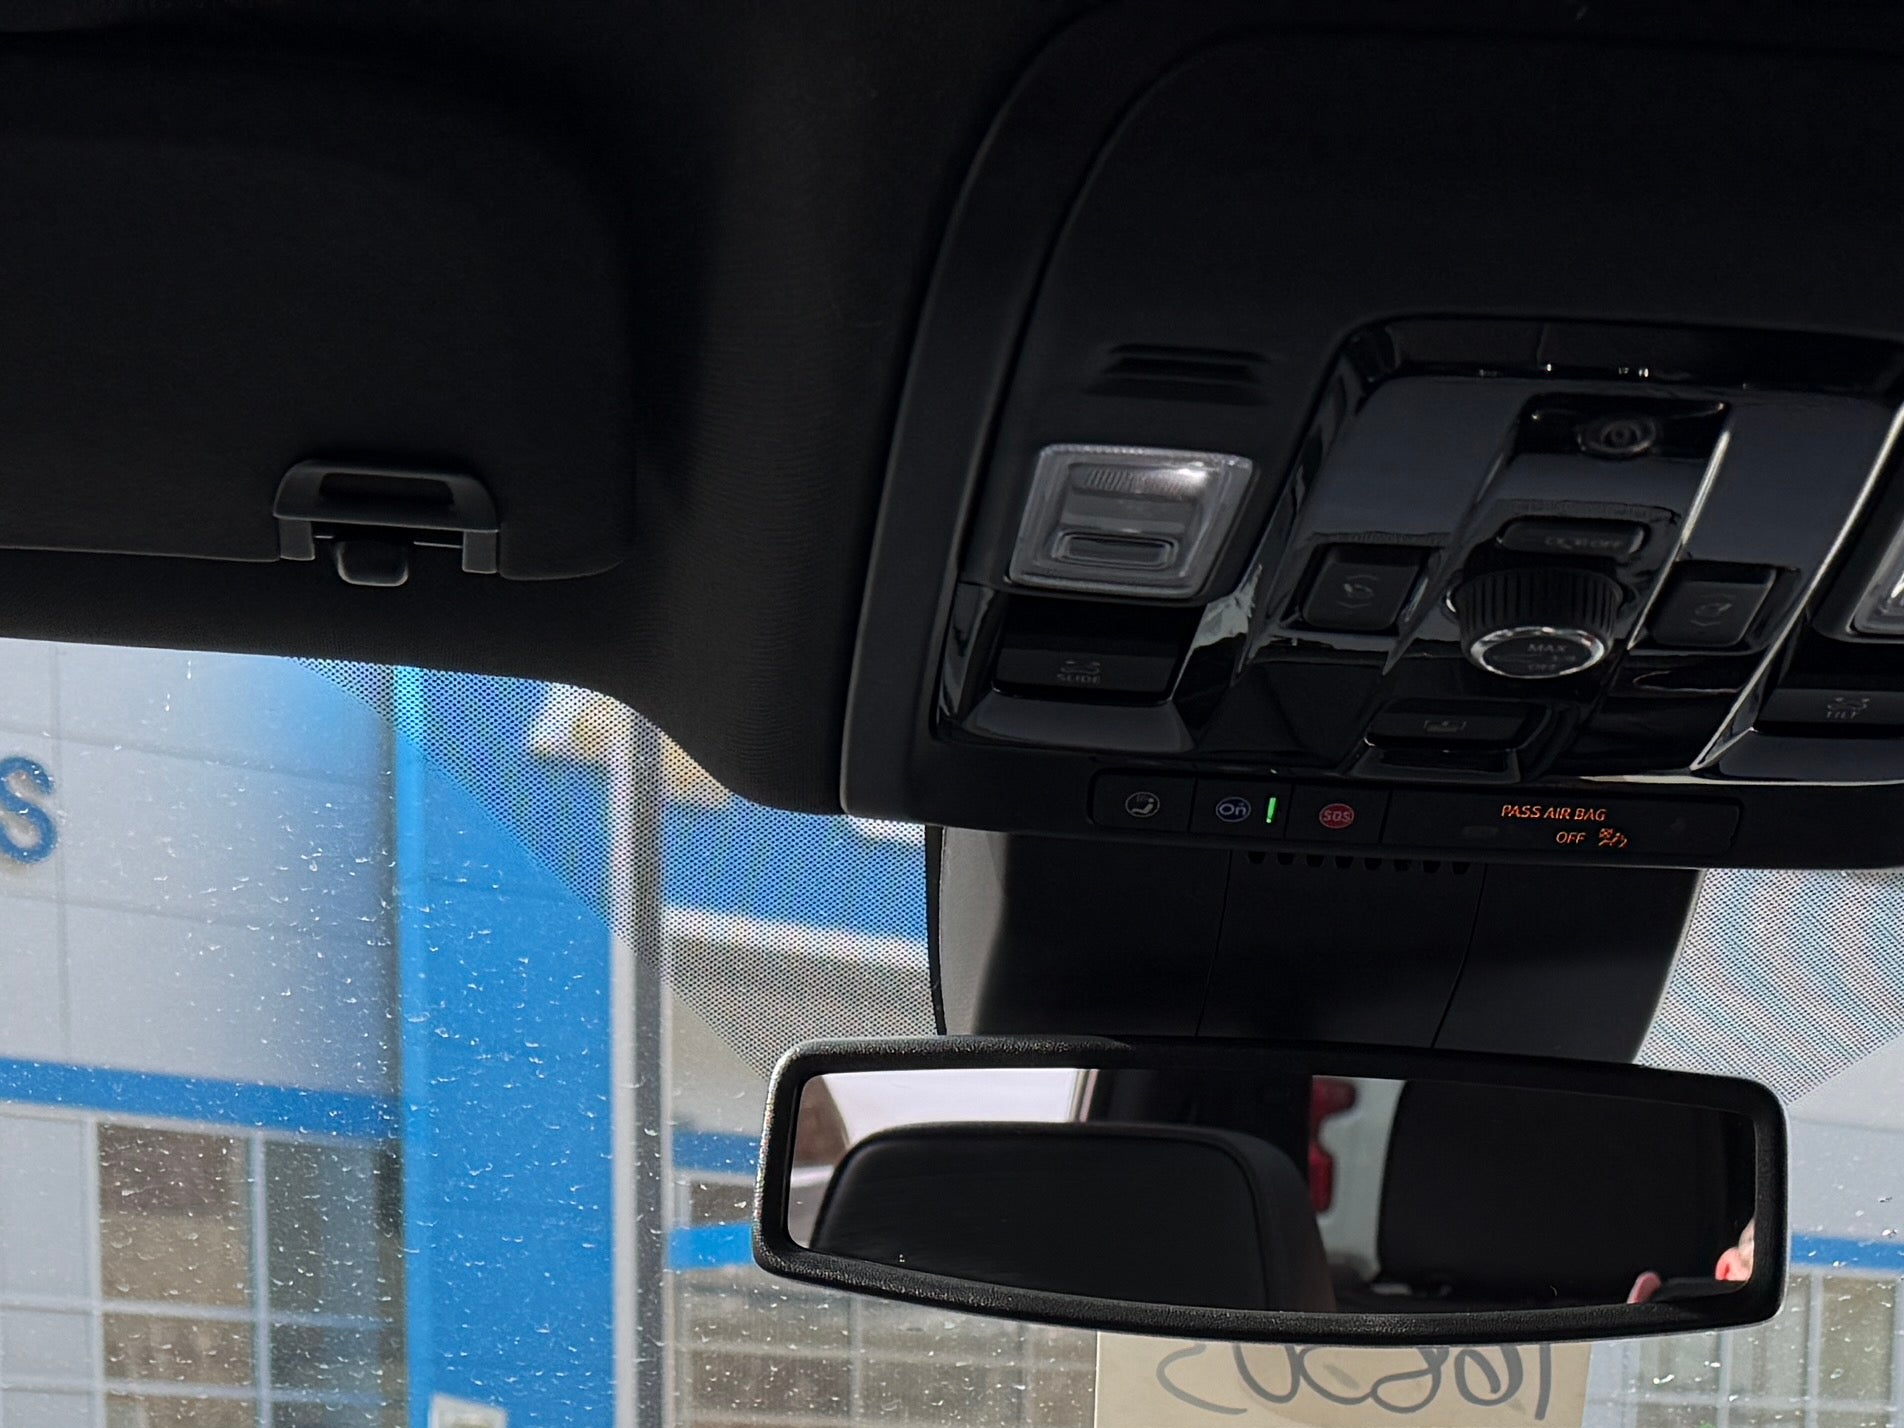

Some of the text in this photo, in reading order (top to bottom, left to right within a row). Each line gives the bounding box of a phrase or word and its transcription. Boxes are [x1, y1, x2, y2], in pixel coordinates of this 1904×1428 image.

[1321, 807, 1353, 824] SOS
[1499, 803, 1608, 823] PASS AIR BAG
[1554, 829, 1587, 846] OFF
